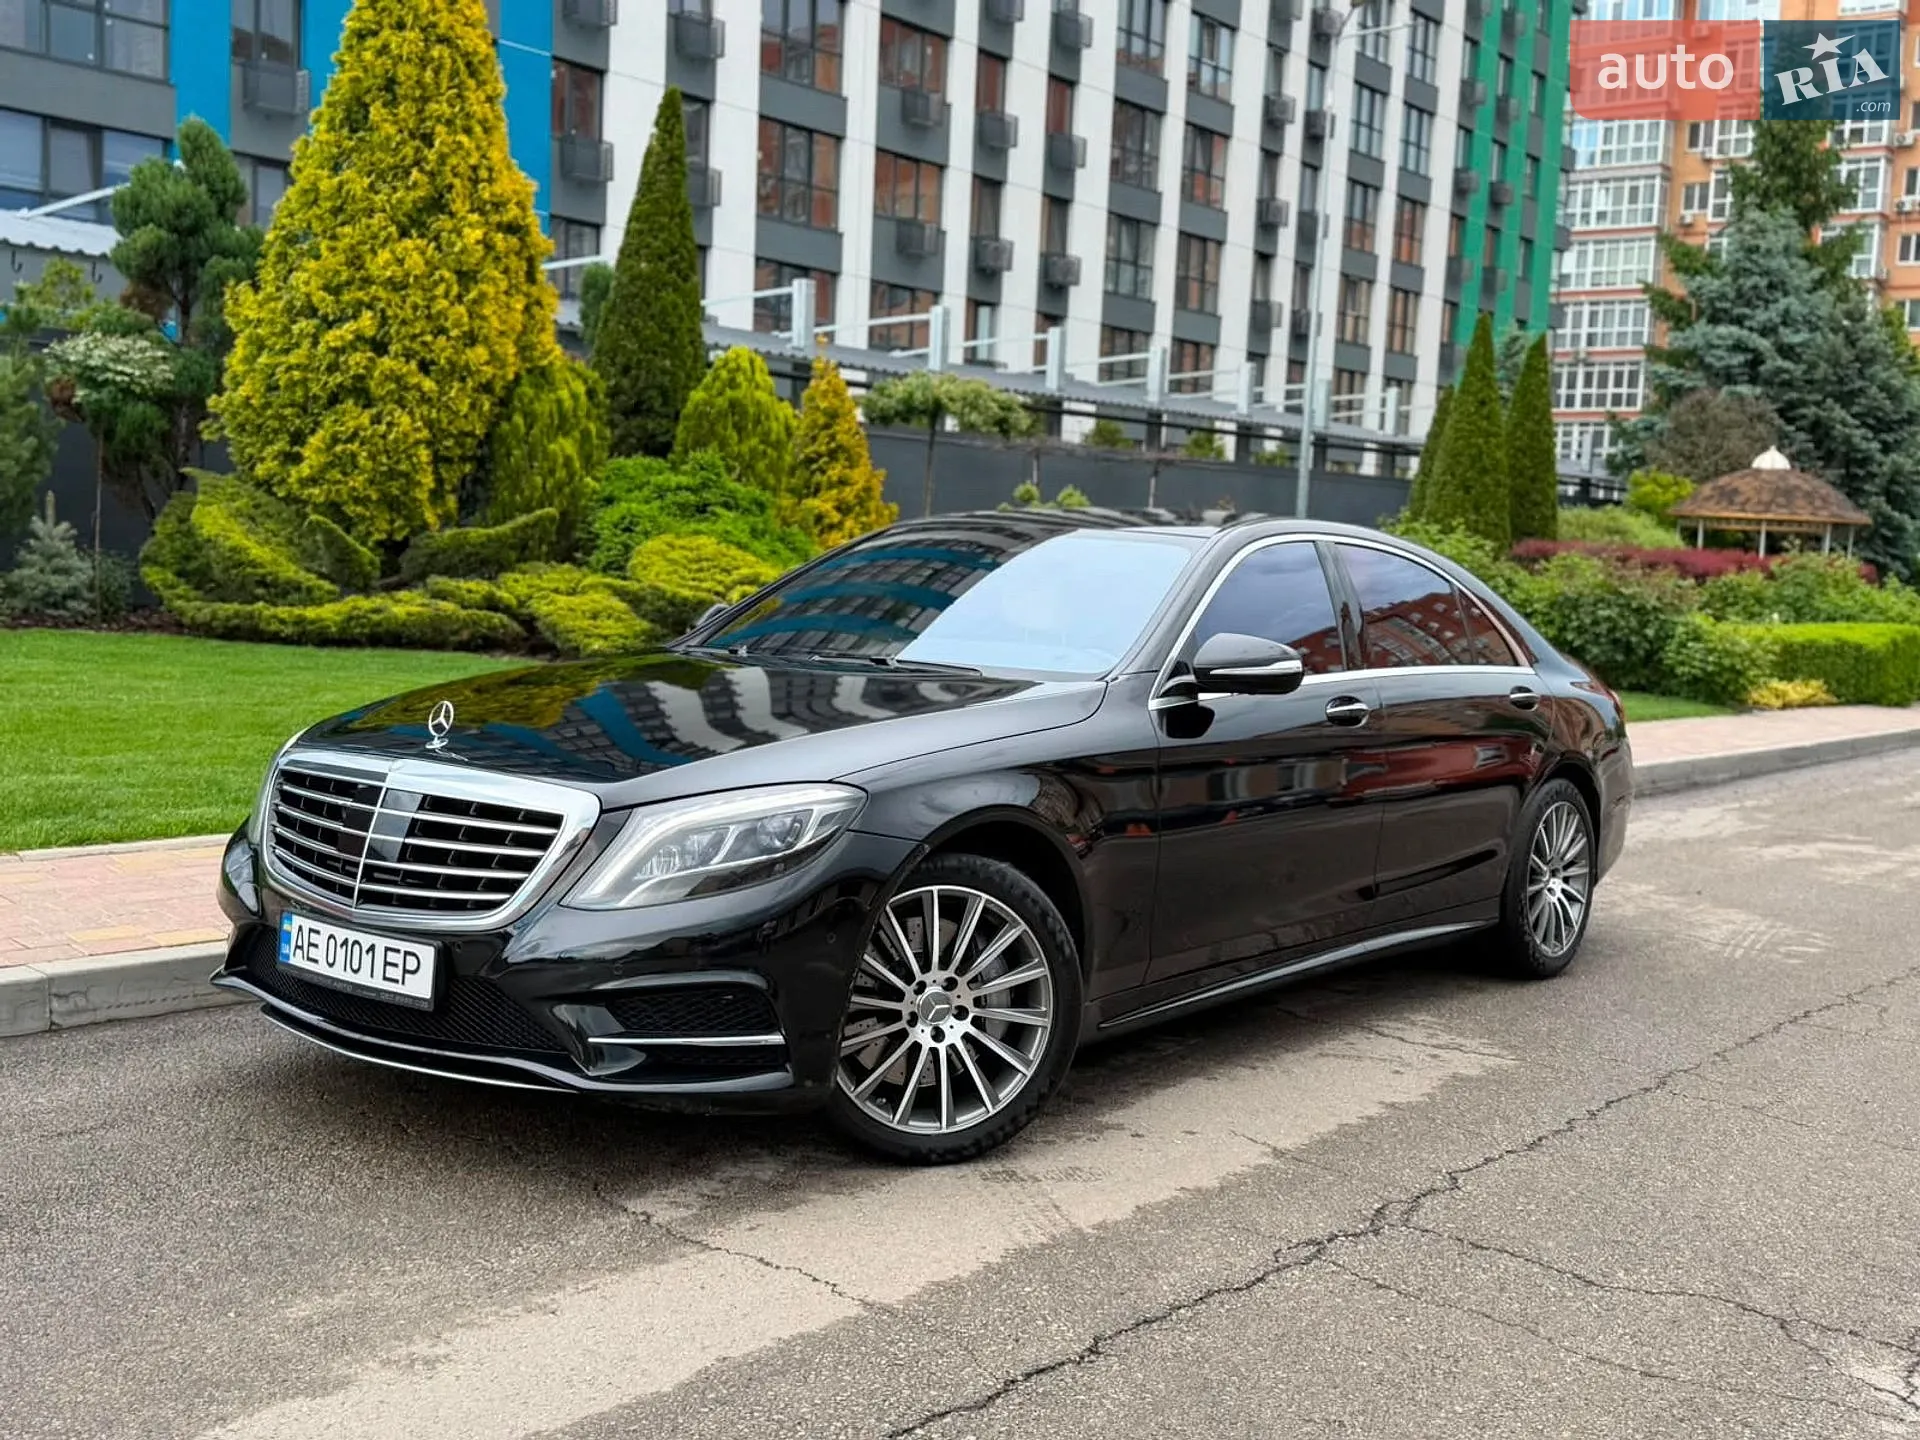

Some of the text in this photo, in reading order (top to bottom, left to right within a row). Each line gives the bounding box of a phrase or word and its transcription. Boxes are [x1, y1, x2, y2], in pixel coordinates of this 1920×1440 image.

[293, 924, 421, 985] AE 0101 EP
